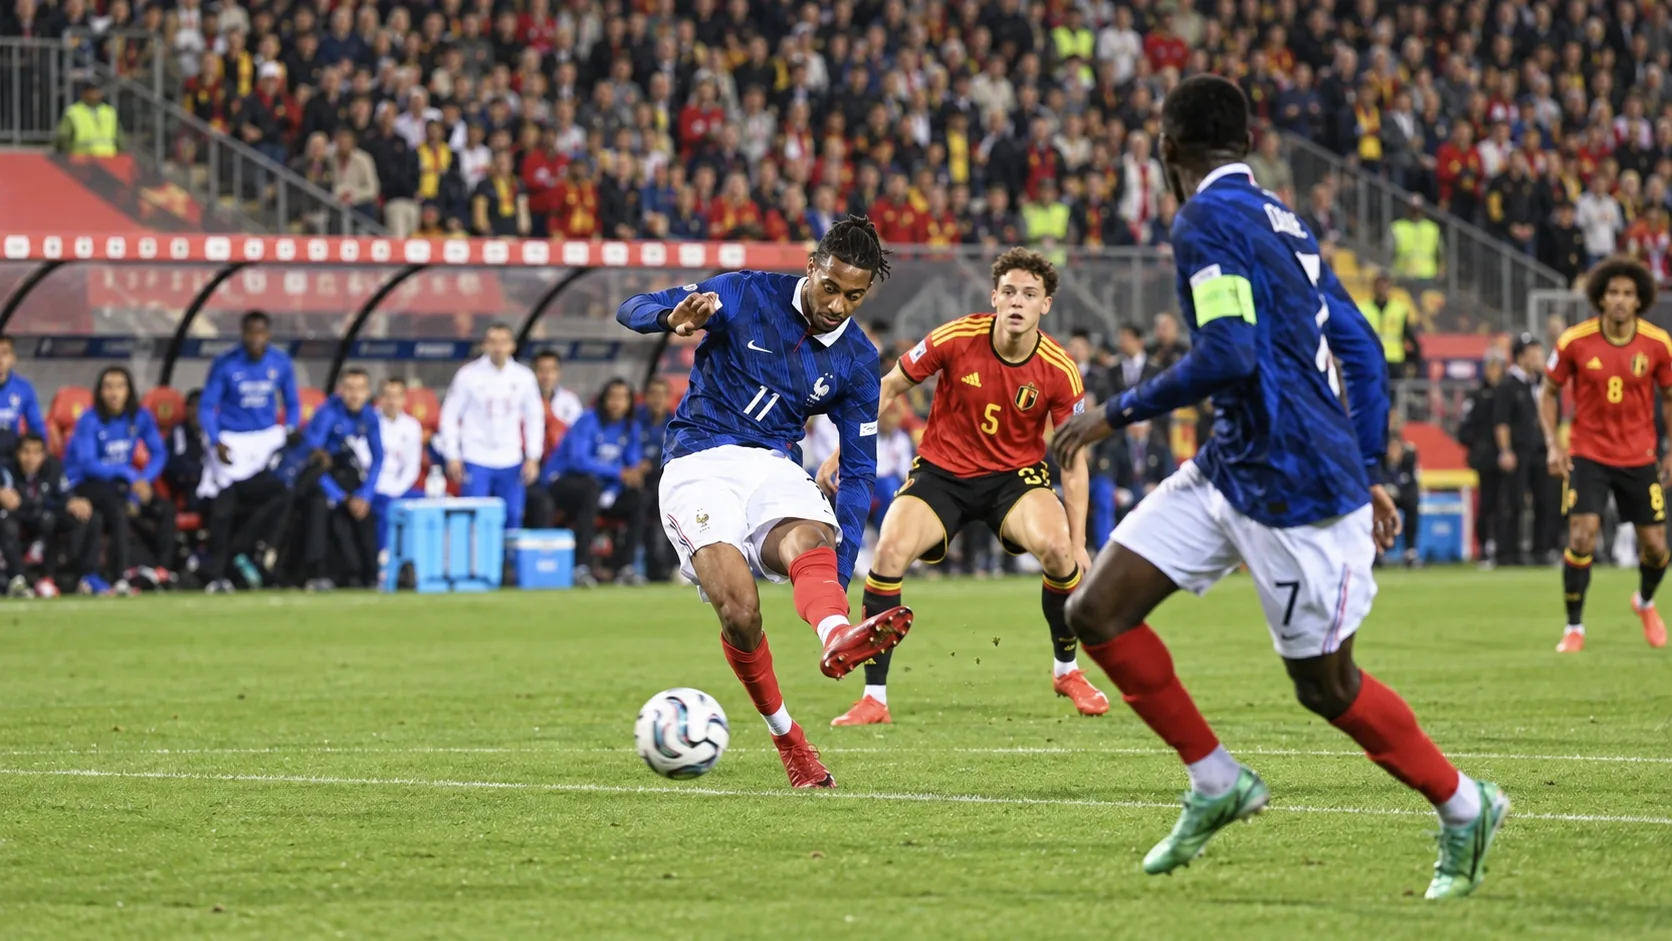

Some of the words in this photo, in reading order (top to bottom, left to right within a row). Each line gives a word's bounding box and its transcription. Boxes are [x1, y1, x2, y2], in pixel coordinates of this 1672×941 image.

[743, 385, 780, 422] 11
[1608, 376, 1623, 403] 8
[981, 403, 1002, 435] 5
[1649, 483, 1664, 511] 8
[1275, 580, 1300, 627] 7
